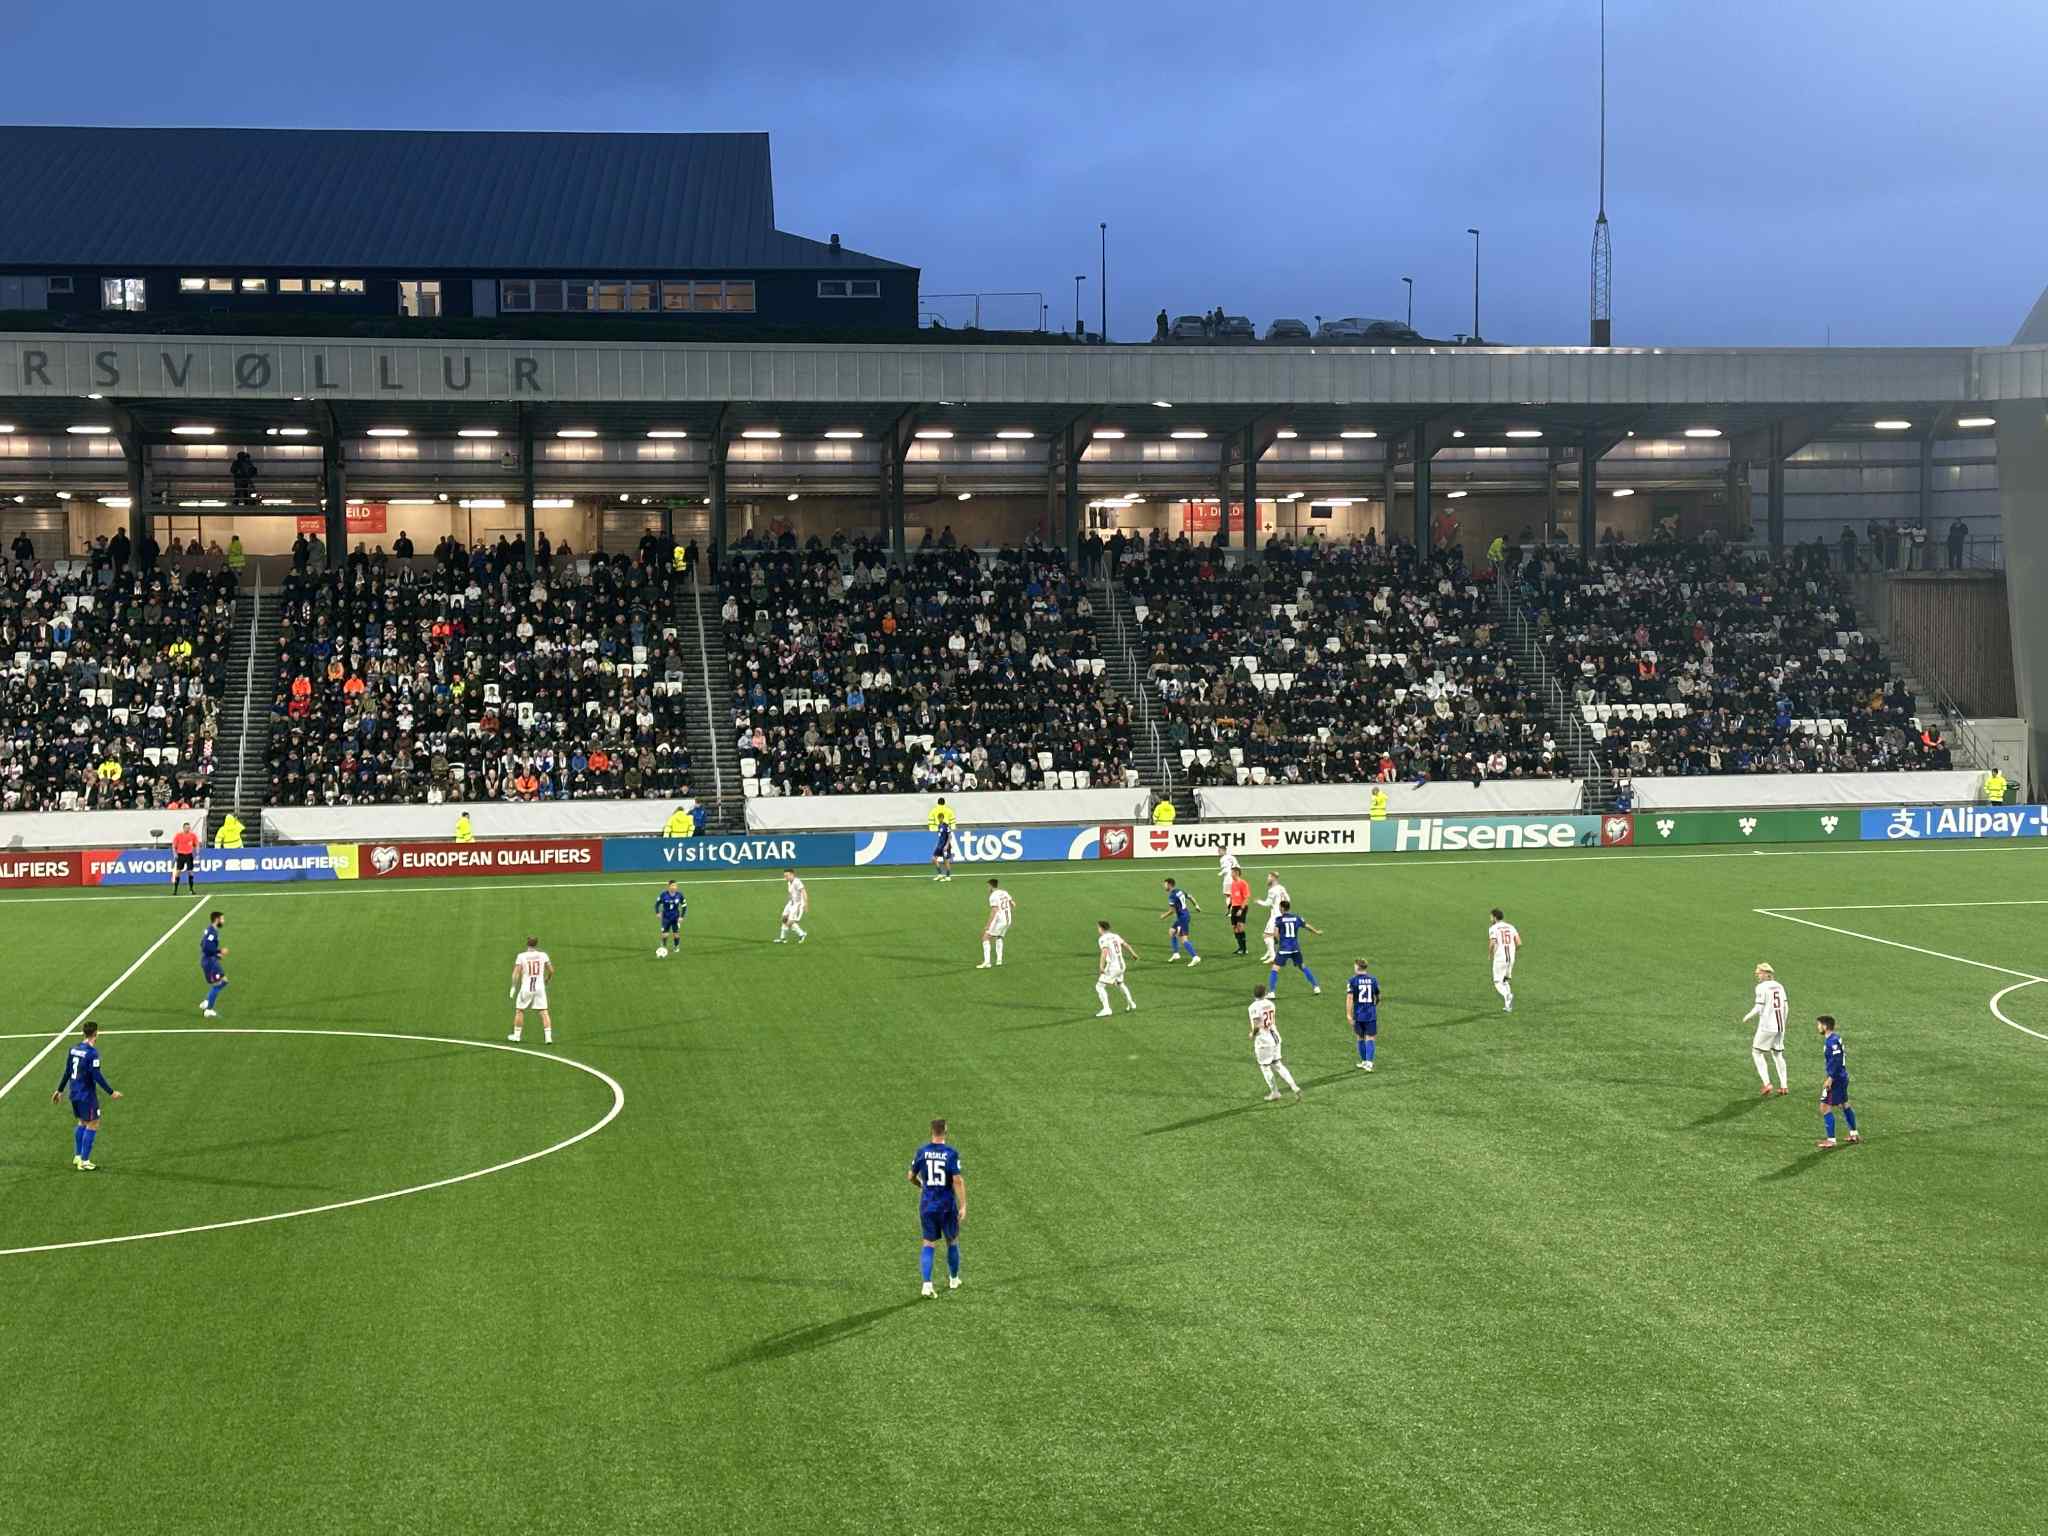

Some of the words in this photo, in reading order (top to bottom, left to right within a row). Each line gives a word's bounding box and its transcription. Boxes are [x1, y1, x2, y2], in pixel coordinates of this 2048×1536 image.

[1936, 807, 2026, 838] Alipay
[1395, 818, 1576, 851] Hisense
[90, 861, 127, 875] FIFA
[128, 860, 188, 874] WORL
[261, 855, 350, 871] QUALIFIERS
[402, 851, 493, 868] EUROPEAN
[497, 848, 592, 866] QUALIFIERS
[1284, 922, 1296, 938] 11
[528, 960, 540, 976] 10
[1358, 984, 1373, 1003] 21
[1773, 991, 1781, 1009] 5
[926, 1160, 946, 1186] 15
